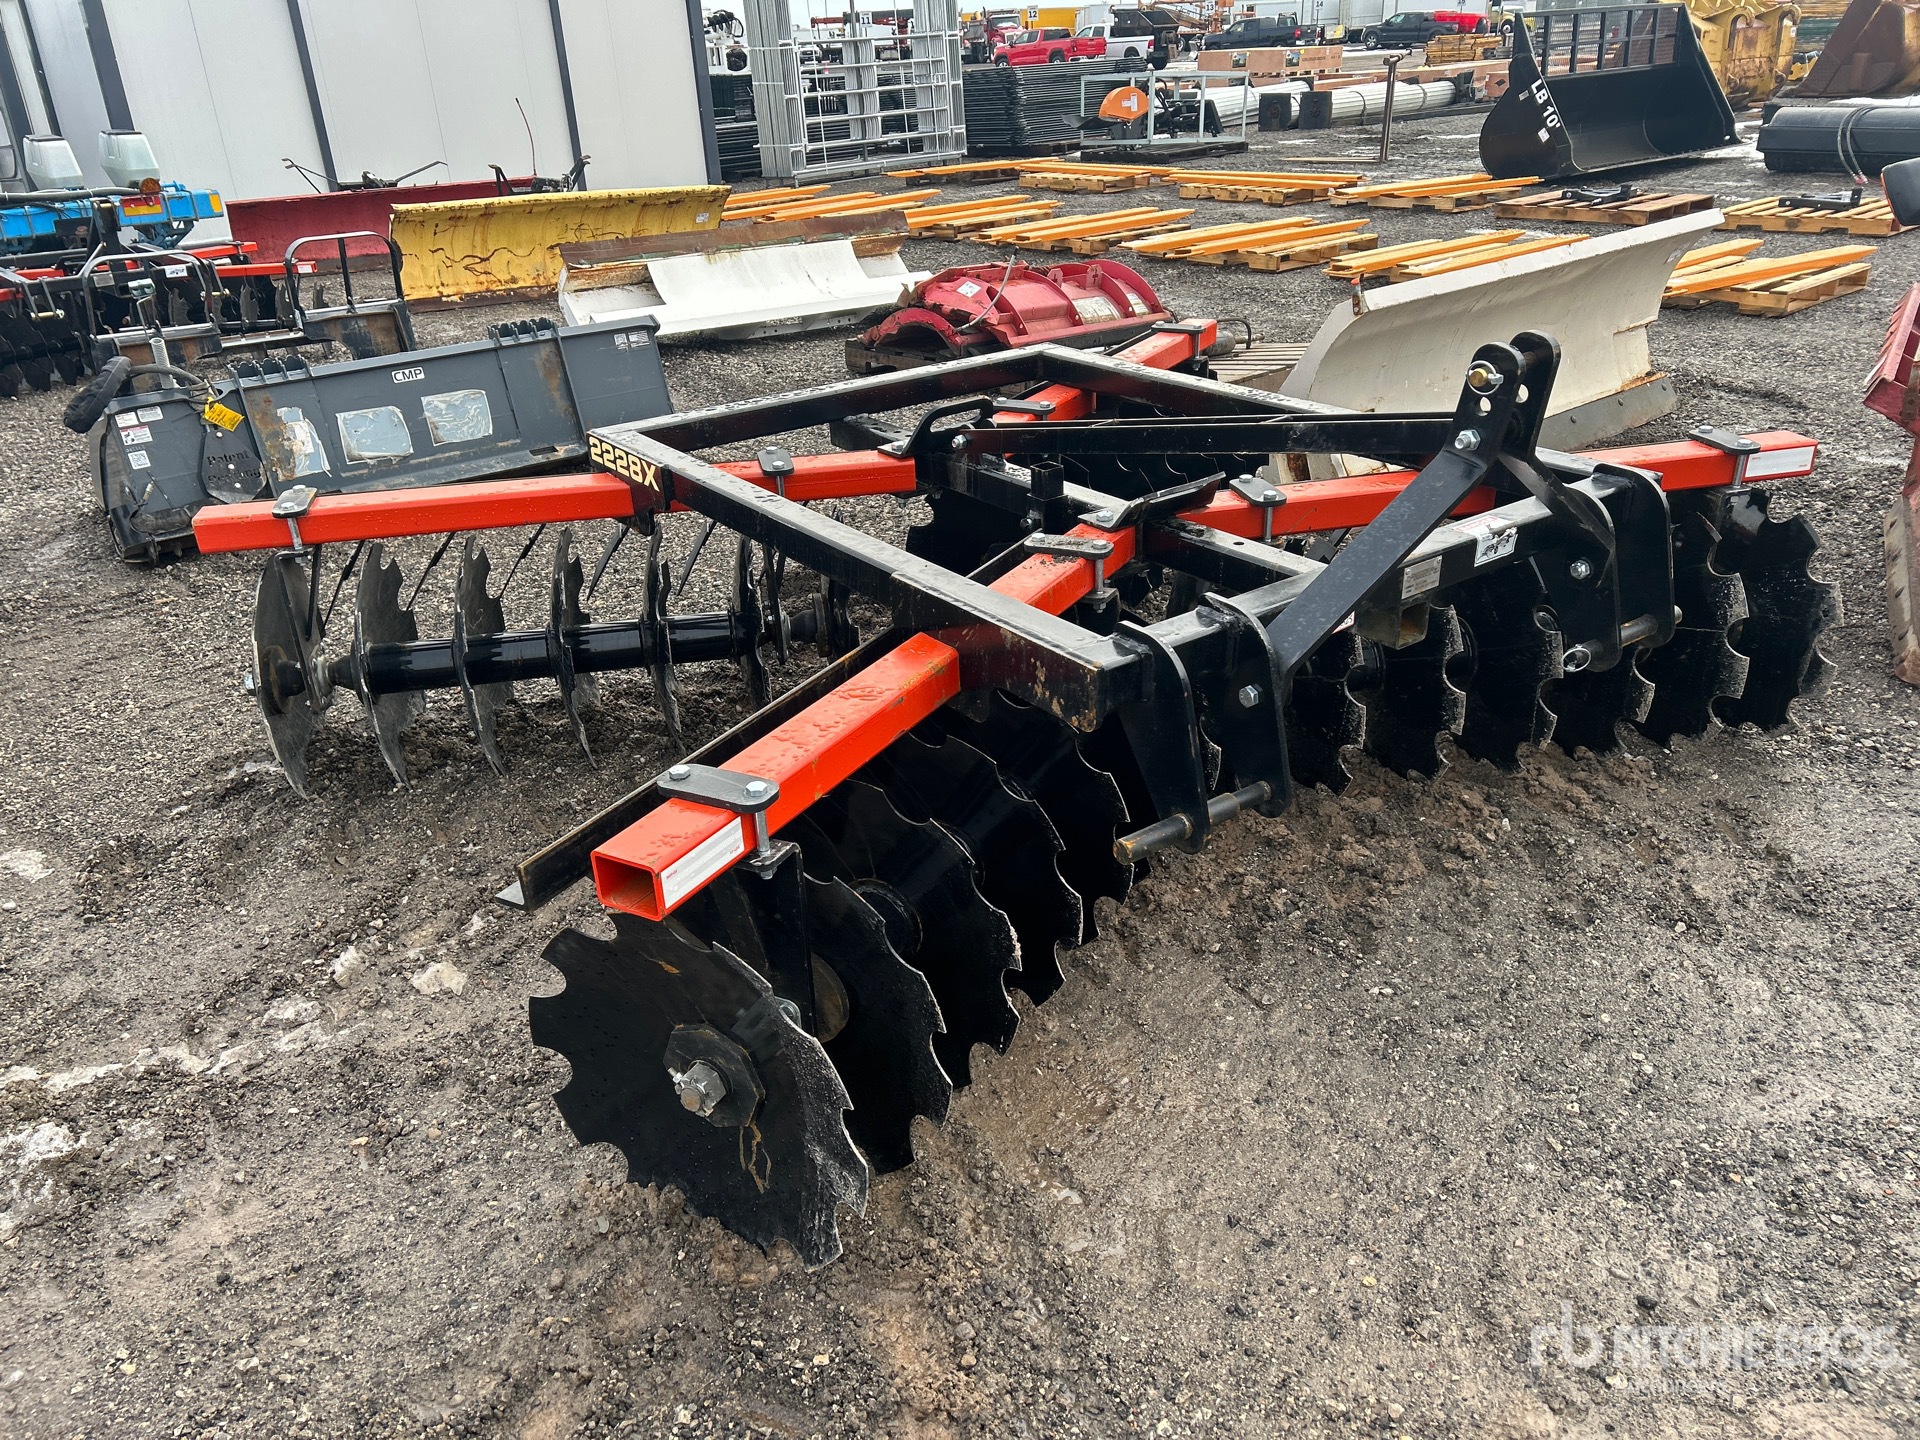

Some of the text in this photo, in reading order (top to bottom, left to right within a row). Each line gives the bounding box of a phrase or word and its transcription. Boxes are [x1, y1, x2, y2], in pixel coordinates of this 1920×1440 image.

[861, 16, 871, 25] 11
[1028, 10, 1038, 18] 12
[1531, 78, 1561, 128] LB 10'
[393, 368, 423, 382] CMP
[207, 450, 249, 466] Patent
[588, 436, 660, 492] 2228X
